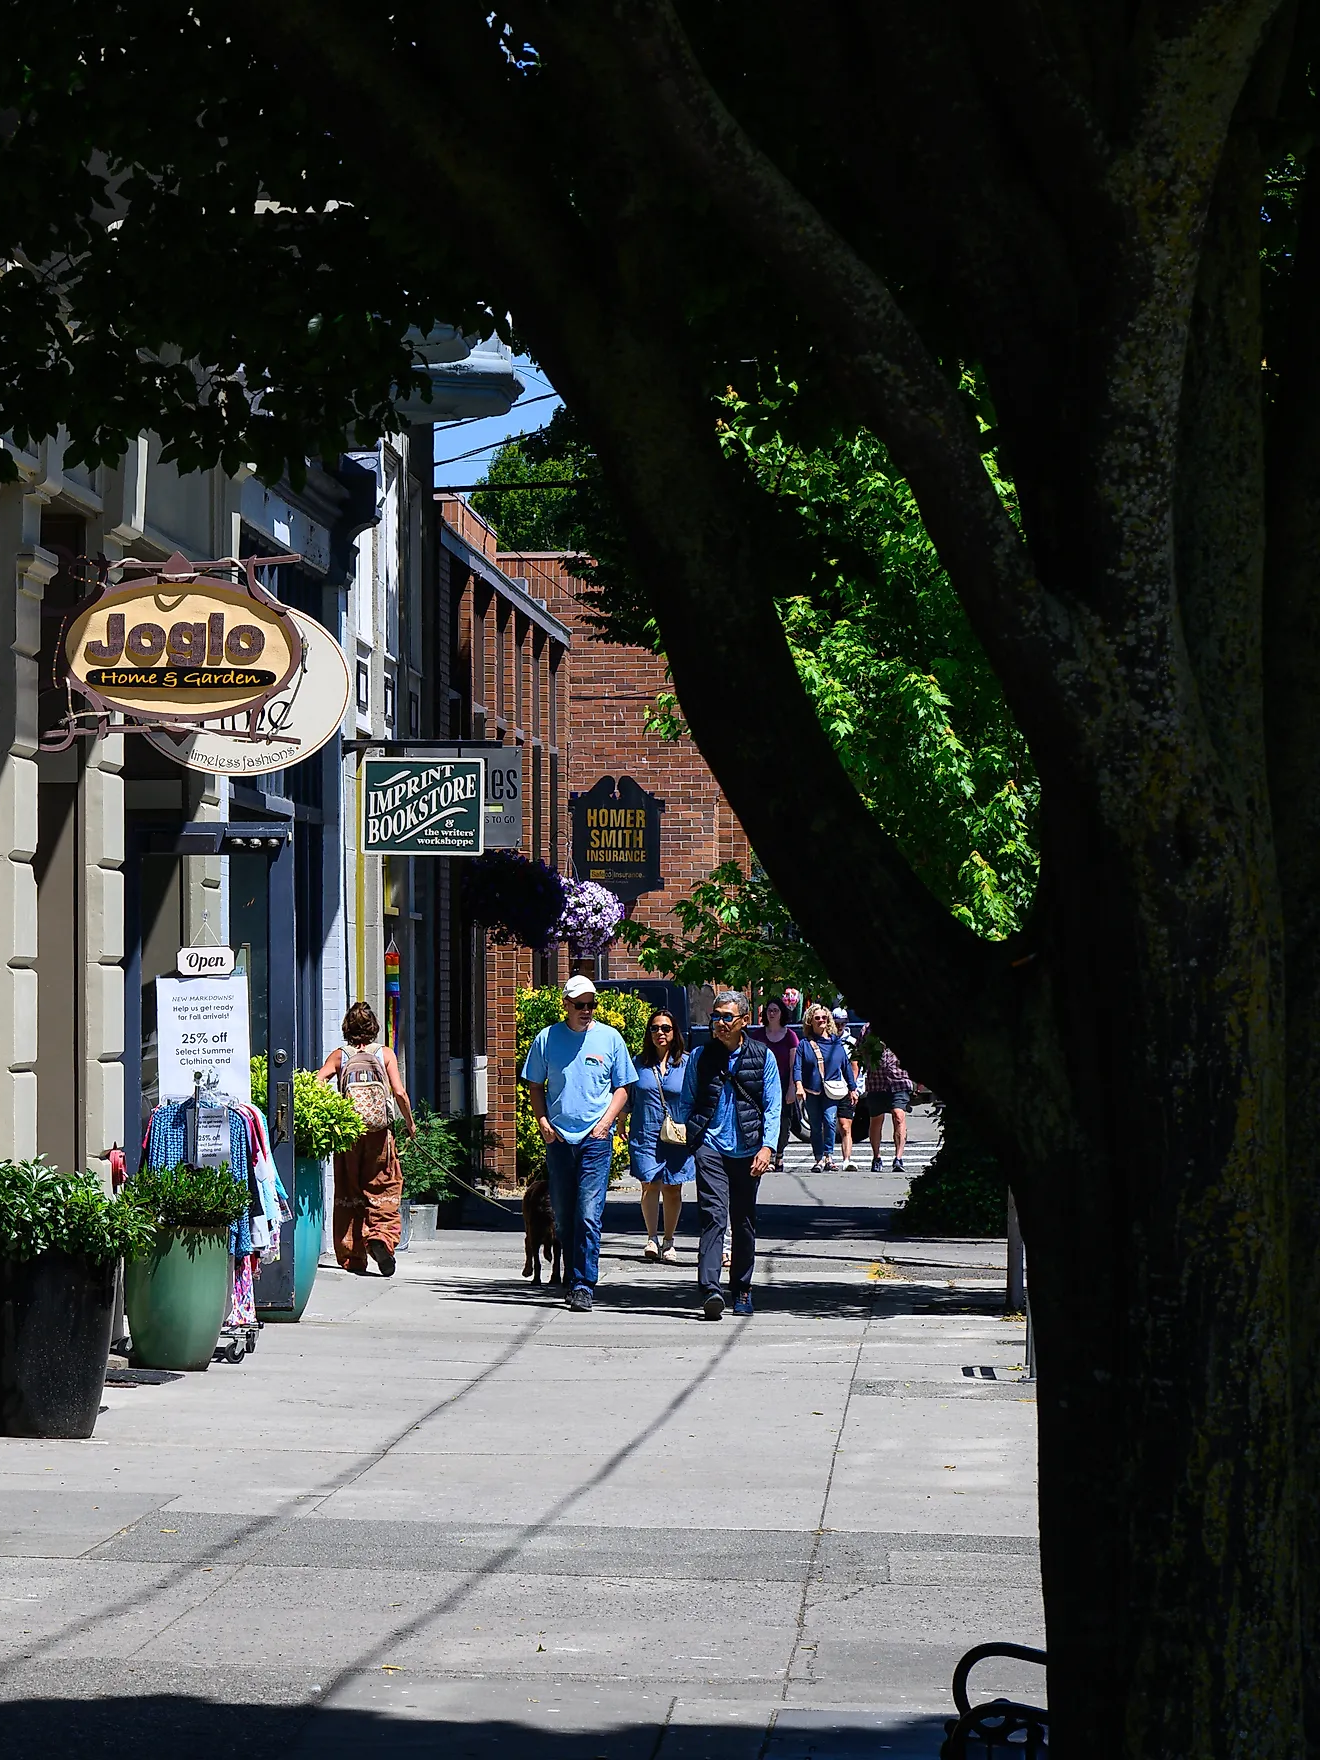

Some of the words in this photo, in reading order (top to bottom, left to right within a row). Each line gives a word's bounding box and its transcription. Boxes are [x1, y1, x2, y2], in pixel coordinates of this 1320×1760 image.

[84, 613, 265, 667] Joglo
[101, 671, 158, 684] Home
[164, 671, 178, 686] &
[184, 671, 260, 684] Garden
[190, 749, 241, 769] timeless
[243, 747, 295, 771] fashions
[368, 764, 455, 818] IMPRINT
[367, 773, 477, 844] BOOKSTORE
[445, 819, 455, 828] &
[492, 815, 502, 824] TO
[504, 815, 516, 824] GO
[587, 808, 646, 828] HOMER
[424, 829, 440, 837] the
[441, 829, 476, 837] writers'
[590, 829, 644, 849] SMITH
[416, 838, 474, 847] workshoppe
[586, 849, 646, 862] INSURANCE
[185, 952, 226, 972] Open
[199, 1004, 211, 1012] get
[181, 1032, 208, 1044] 25%
[211, 1031, 228, 1043] off
[175, 1047, 200, 1055] Select
[201, 1047, 234, 1055] Summer
[214, 1056, 231, 1065] and
